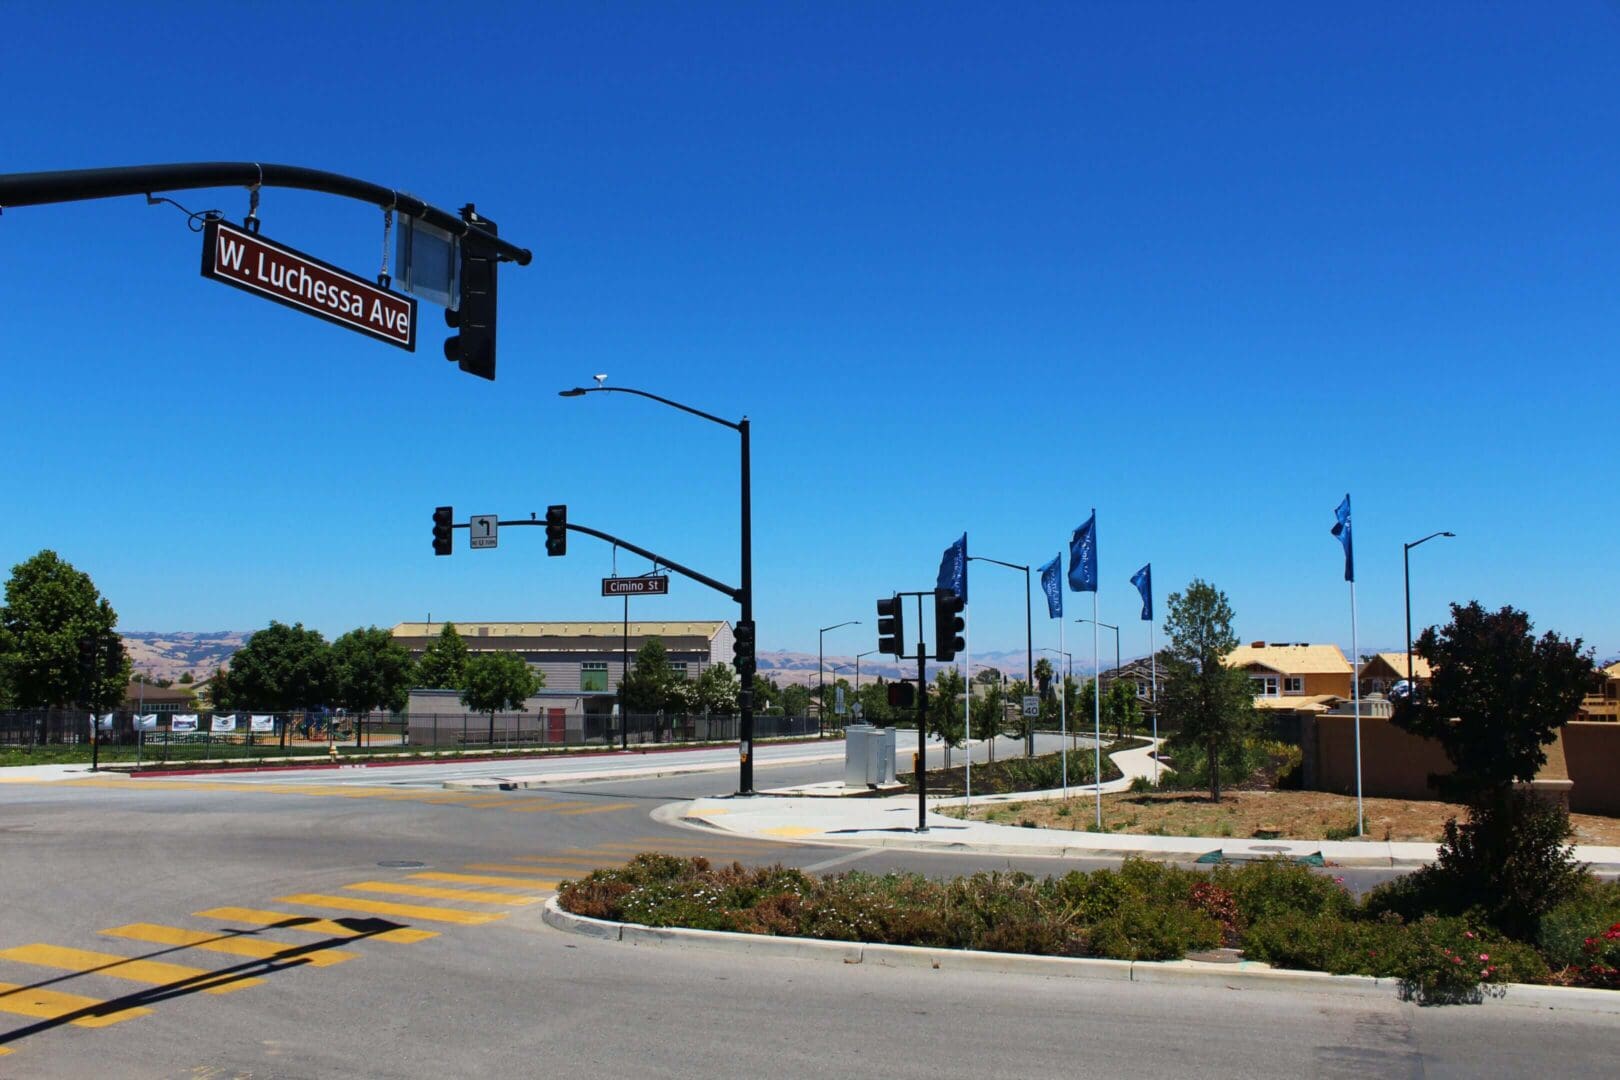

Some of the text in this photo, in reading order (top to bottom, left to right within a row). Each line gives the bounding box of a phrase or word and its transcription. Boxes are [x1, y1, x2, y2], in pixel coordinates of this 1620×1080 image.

[219, 236, 408, 334] W. Luchessa Ave
[610, 580, 658, 592] Cimino St
[1025, 707, 1038, 715] 40
